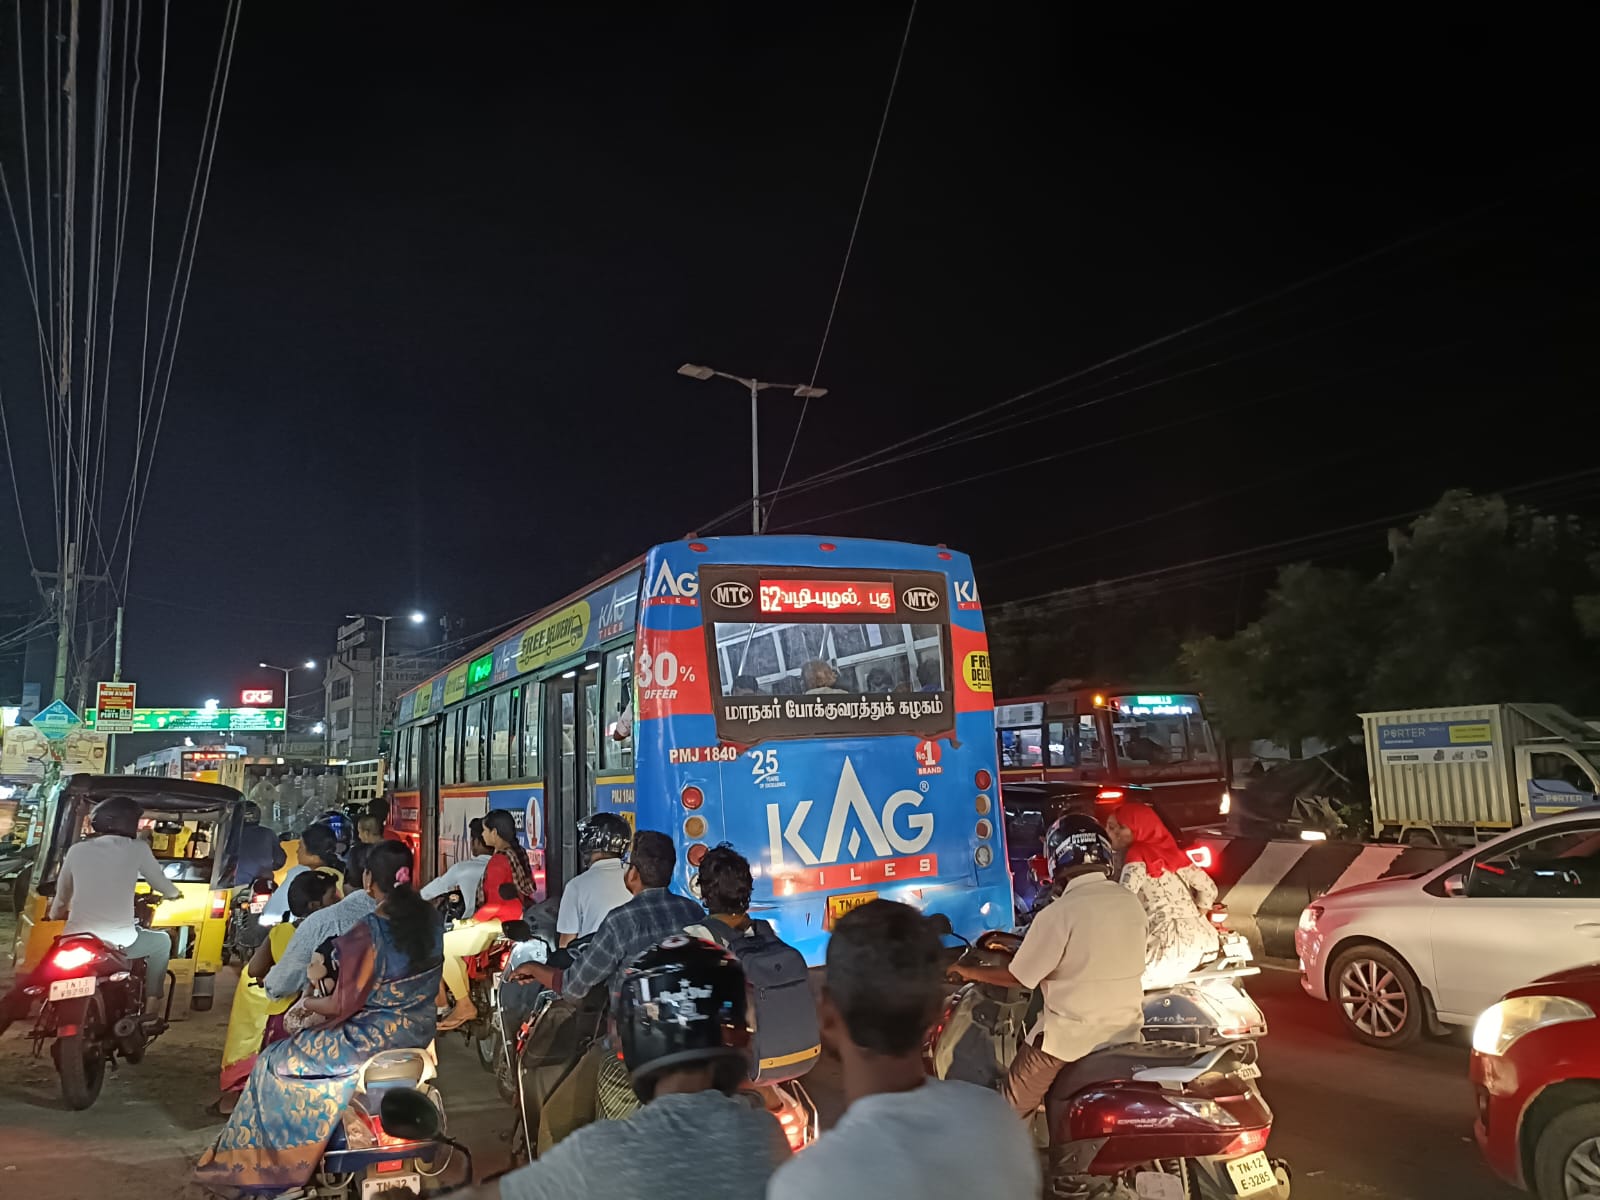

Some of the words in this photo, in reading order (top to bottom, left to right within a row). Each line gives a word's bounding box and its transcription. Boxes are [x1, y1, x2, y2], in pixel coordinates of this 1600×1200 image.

[715, 586, 750, 605] MTC
[907, 589, 937, 607] MTC
[521, 631, 546, 656] FREE
[545, 614, 573, 645] DELIVERY
[599, 620, 624, 640] TILES
[644, 688, 679, 700] OFFER
[724, 700, 781, 725] மாநகர்
[898, 694, 945, 721] கழகம்
[1383, 727, 1427, 739] PORTER
[669, 747, 700, 763] PMJ
[703, 745, 738, 762] 1840
[751, 749, 779, 775] 25
[918, 766, 942, 775] BRAND
[1545, 794, 1583, 803] PORTER
[765, 755, 935, 866] KAG
[839, 900, 852, 912] TN
[1237, 1157, 1263, 1174] TN-12
[1240, 1171, 1271, 1190] E-3285
